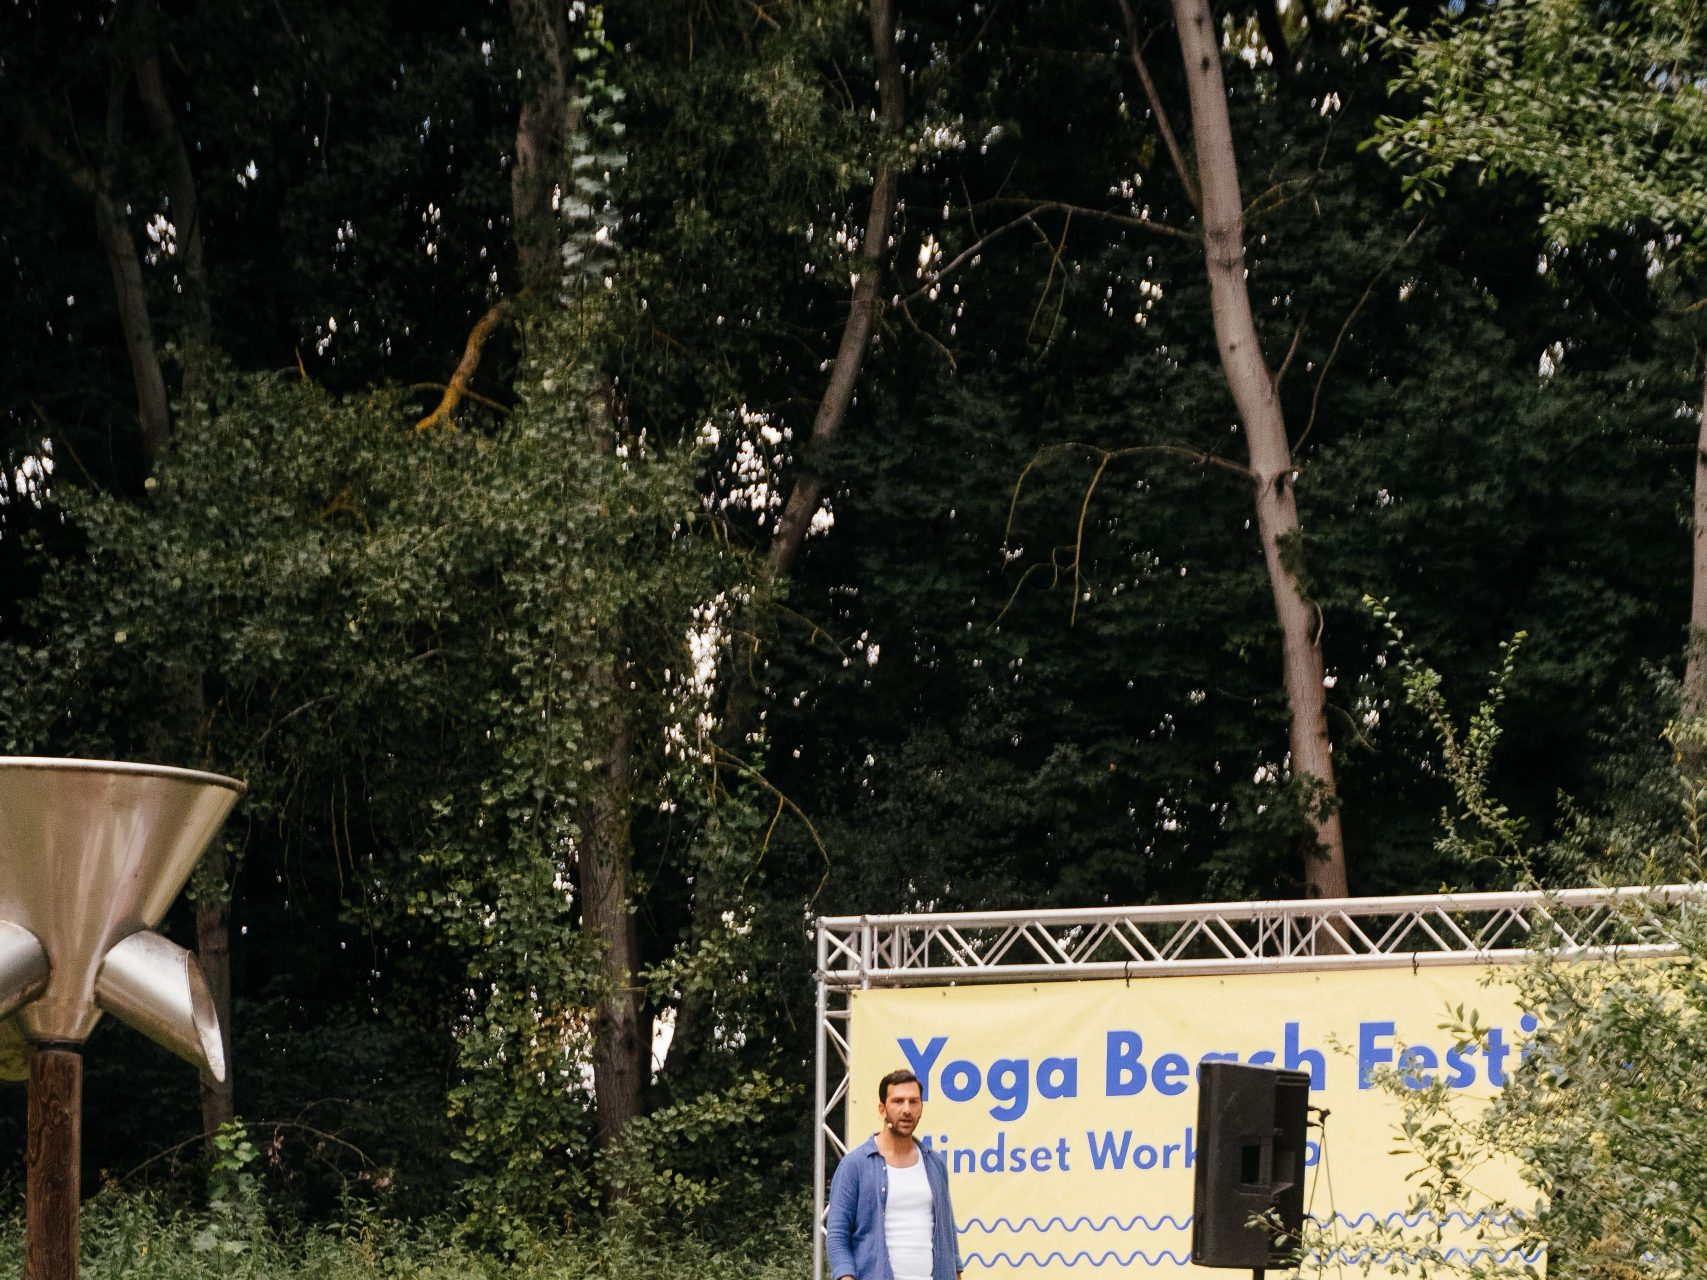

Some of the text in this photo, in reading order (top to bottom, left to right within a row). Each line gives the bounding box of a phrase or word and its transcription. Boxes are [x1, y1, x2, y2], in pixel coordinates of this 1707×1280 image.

[897, 1035, 1078, 1122] Yoga
[1105, 1022, 1326, 1097] Beh
[921, 1131, 1071, 1173] indset
